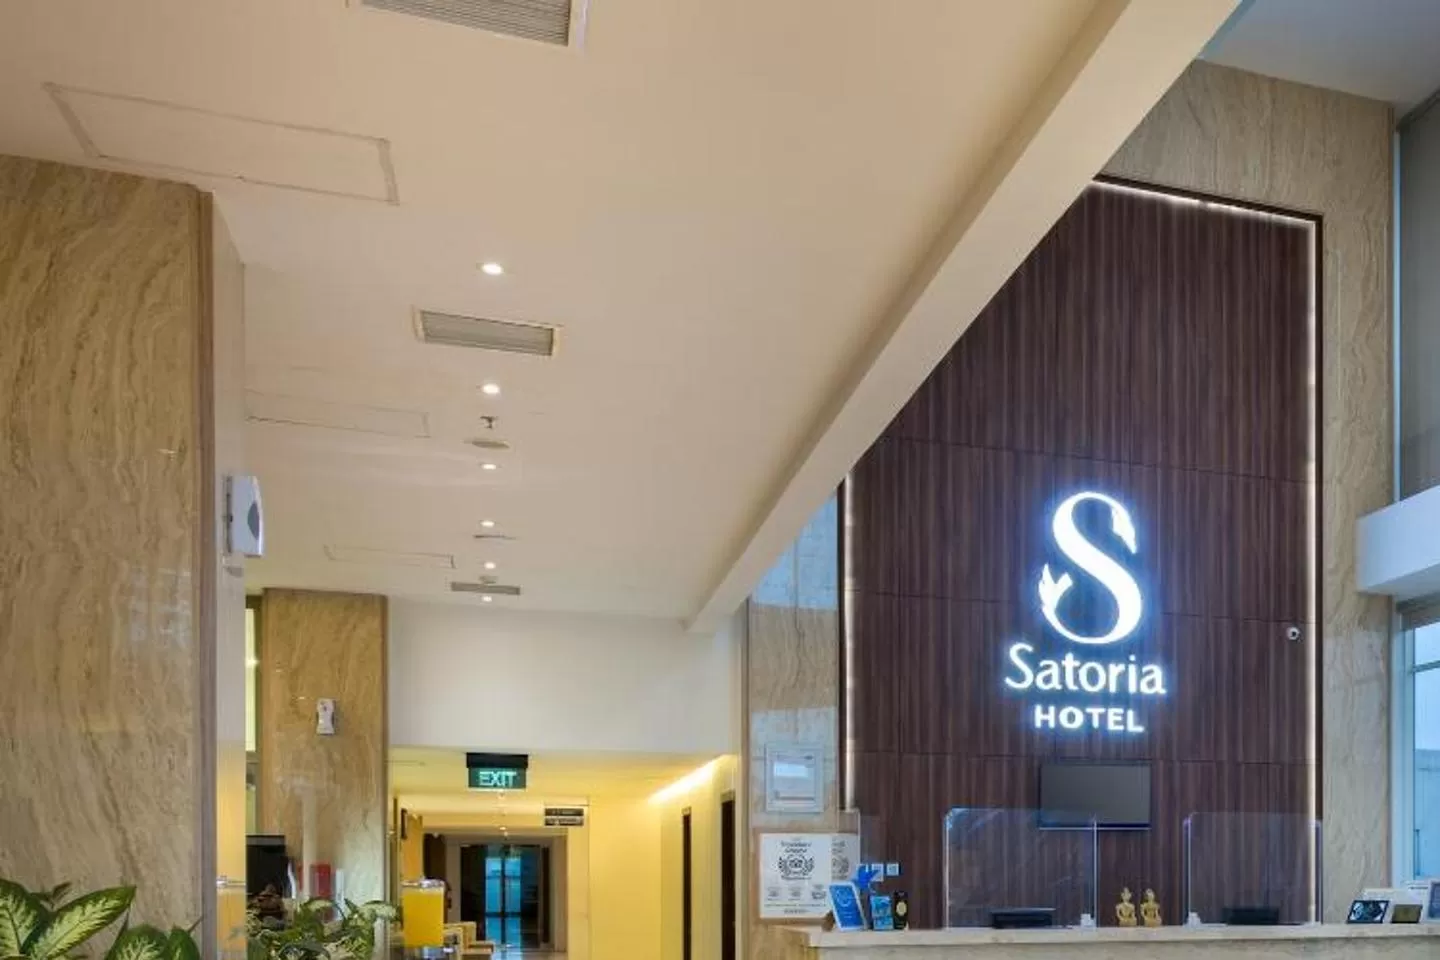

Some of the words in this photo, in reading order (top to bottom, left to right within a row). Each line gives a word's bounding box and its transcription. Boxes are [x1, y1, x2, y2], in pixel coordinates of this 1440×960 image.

[1005, 640, 1167, 695] Satoria
[1034, 705, 1144, 733] HOTEL
[479, 770, 517, 787] EXIT
